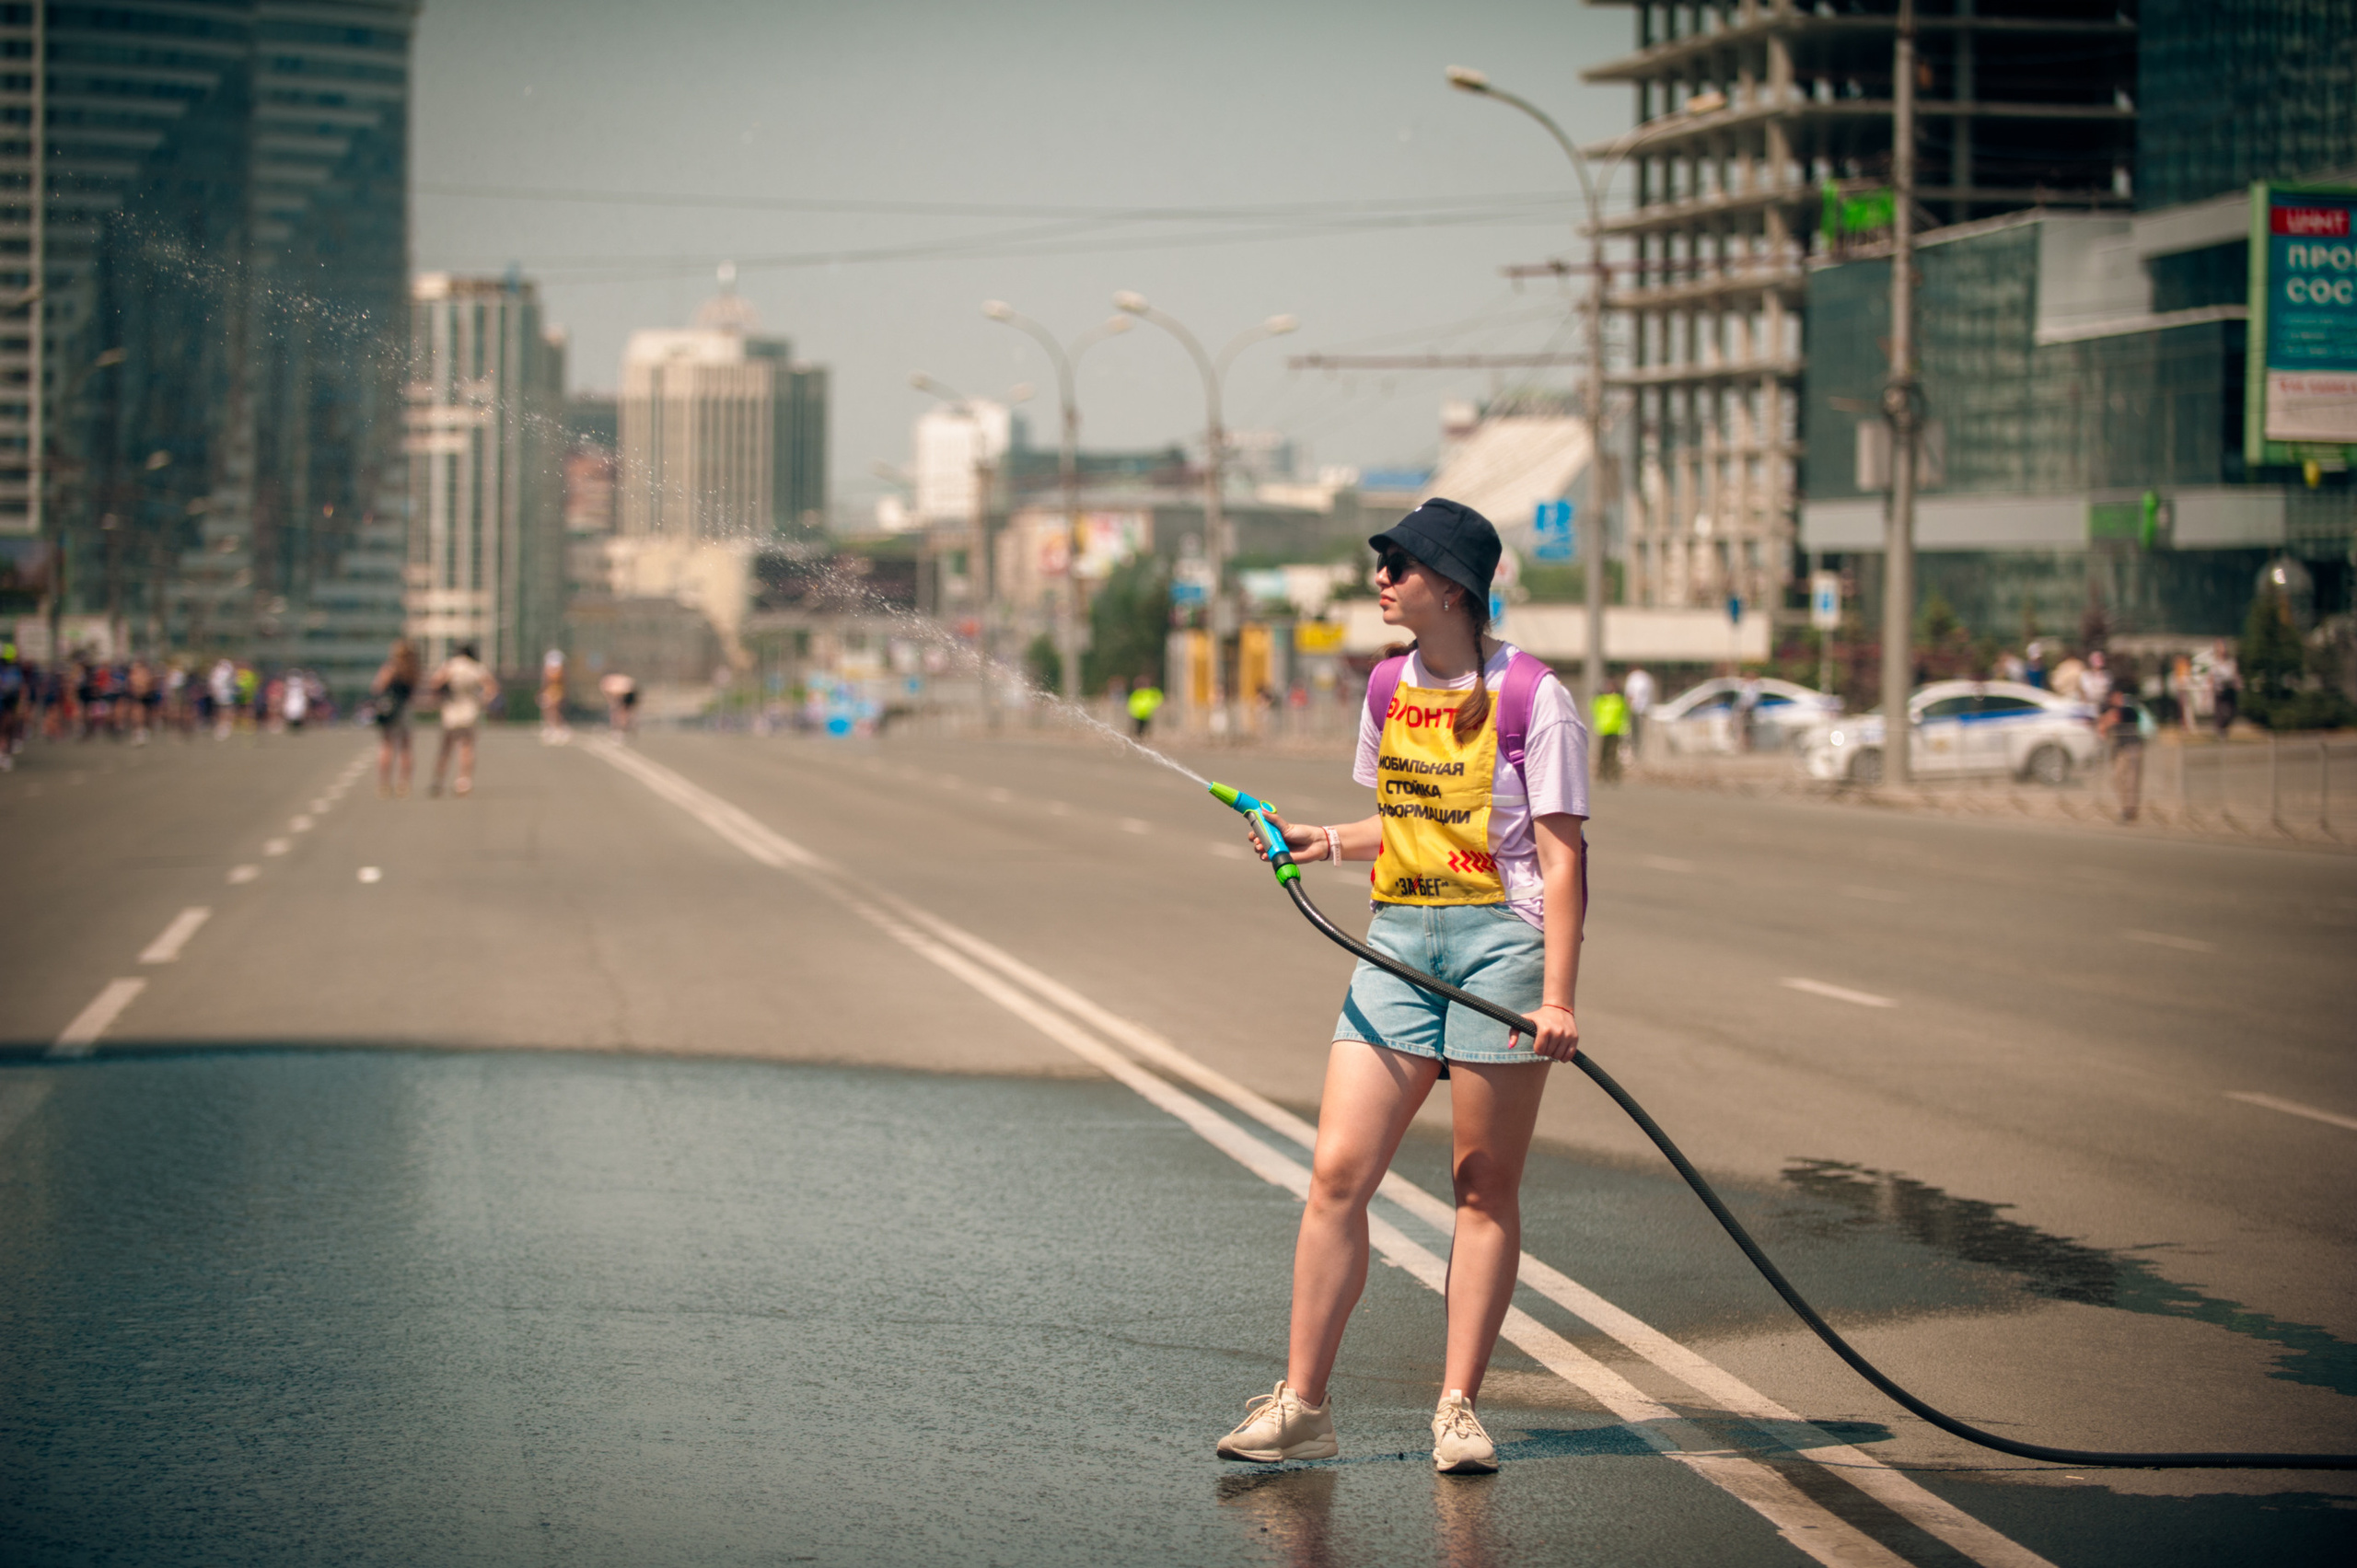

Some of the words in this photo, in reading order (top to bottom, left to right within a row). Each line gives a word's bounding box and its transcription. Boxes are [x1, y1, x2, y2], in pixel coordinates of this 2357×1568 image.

[2288, 244, 2357, 270] ПРО
[1378, 754, 1464, 776] МОБИЛЬНАЯ
[1386, 779, 1442, 799] СТОЙКА
[1377, 802, 1471, 826] НФОРМАЦИИ
